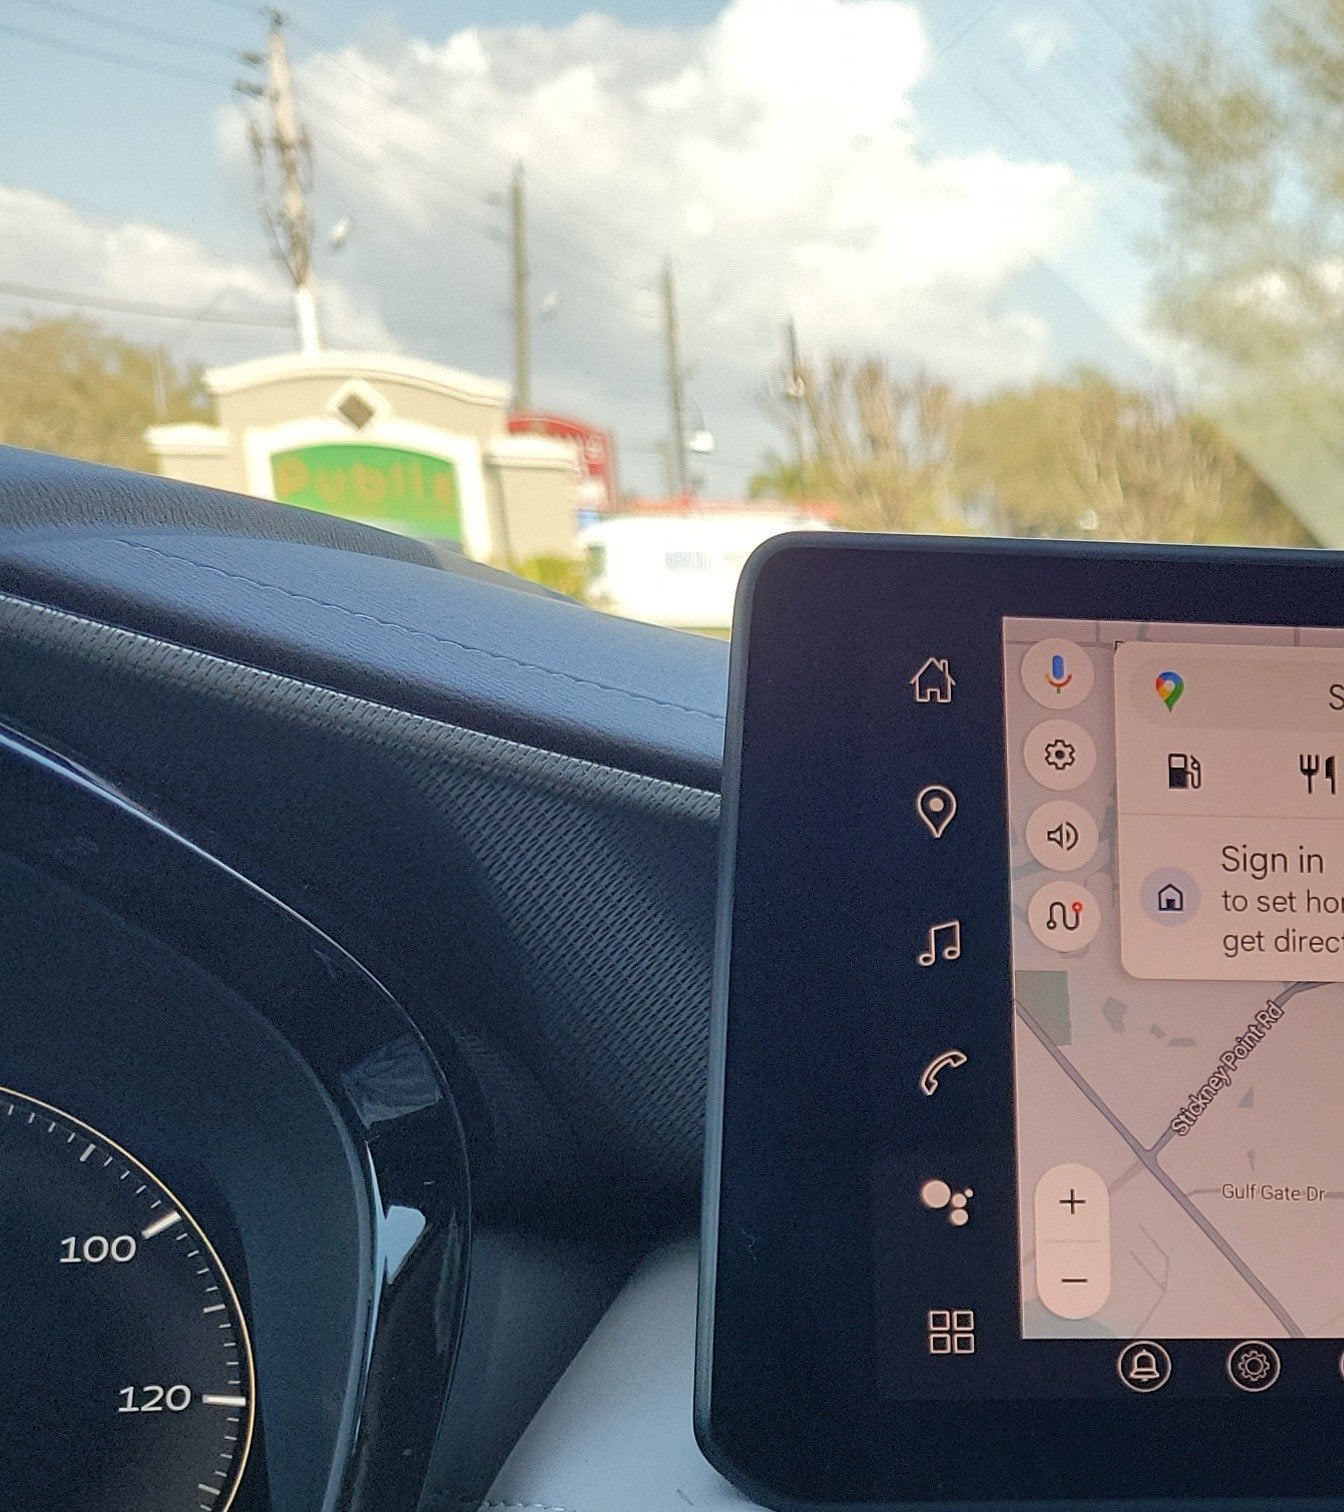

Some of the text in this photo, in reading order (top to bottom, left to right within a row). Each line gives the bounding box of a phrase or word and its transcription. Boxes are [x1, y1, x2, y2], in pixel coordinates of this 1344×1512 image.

[1221, 844, 1324, 879] Sign in
[1223, 889, 1249, 914] to
[1257, 890, 1297, 914] set
[1223, 930, 1265, 959] get
[1170, 999, 1284, 1136] Stickney Point Rd
[1221, 1183, 1325, 1201] Gulf Gate Dr
[59, 1235, 136, 1263] 100
[118, 1385, 192, 1413] 120
